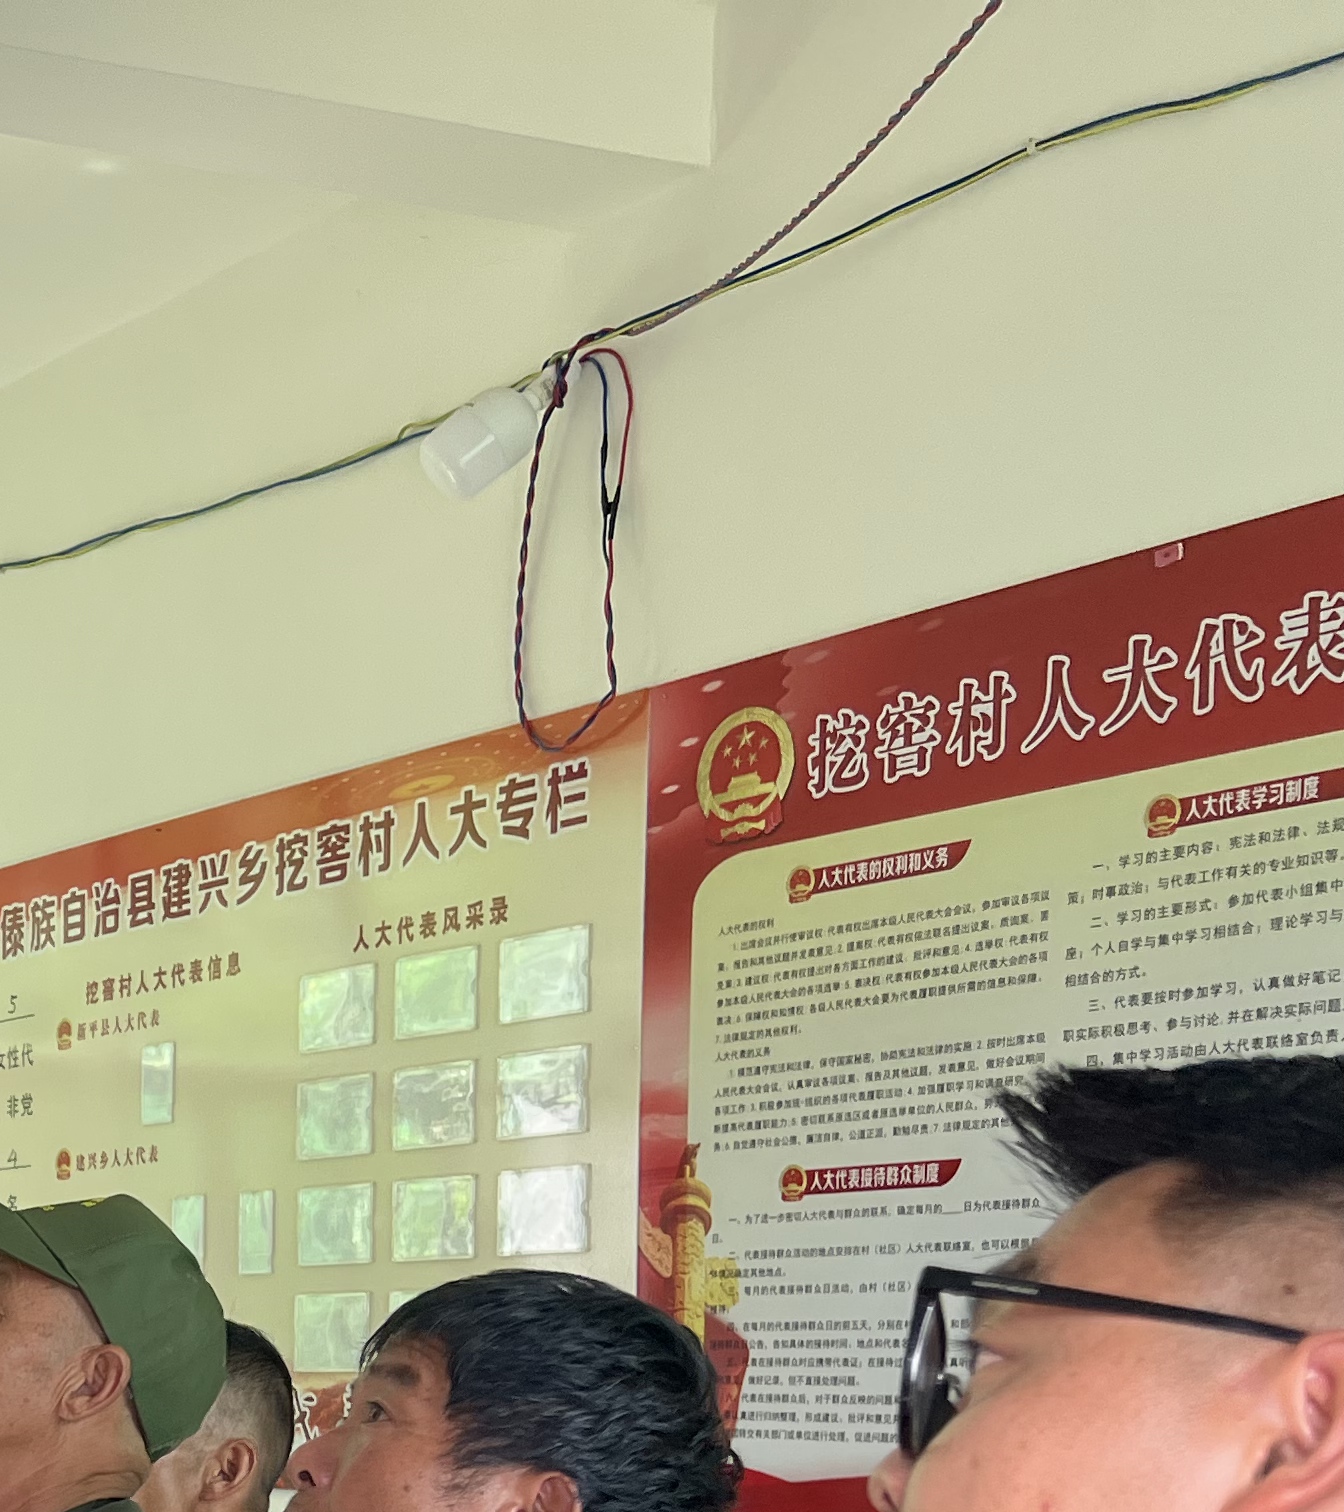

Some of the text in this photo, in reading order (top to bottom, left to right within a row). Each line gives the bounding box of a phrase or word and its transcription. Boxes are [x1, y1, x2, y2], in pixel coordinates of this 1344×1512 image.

[807, 591, 1344, 799] 挖窖村人大代表
[1186, 776, 1320, 821] 人大代表学习制度
[818, 847, 949, 890] 人大代表的权利和义务
[352, 896, 509, 952] 人大代表风采录
[84, 949, 242, 1005] 挖窖村人大代表信息
[76, 1008, 160, 1041] 新平县人大代表
[75, 1145, 159, 1172] 建兴乡人大代表
[810, 1163, 940, 1190] 人大代表接待群众制度
